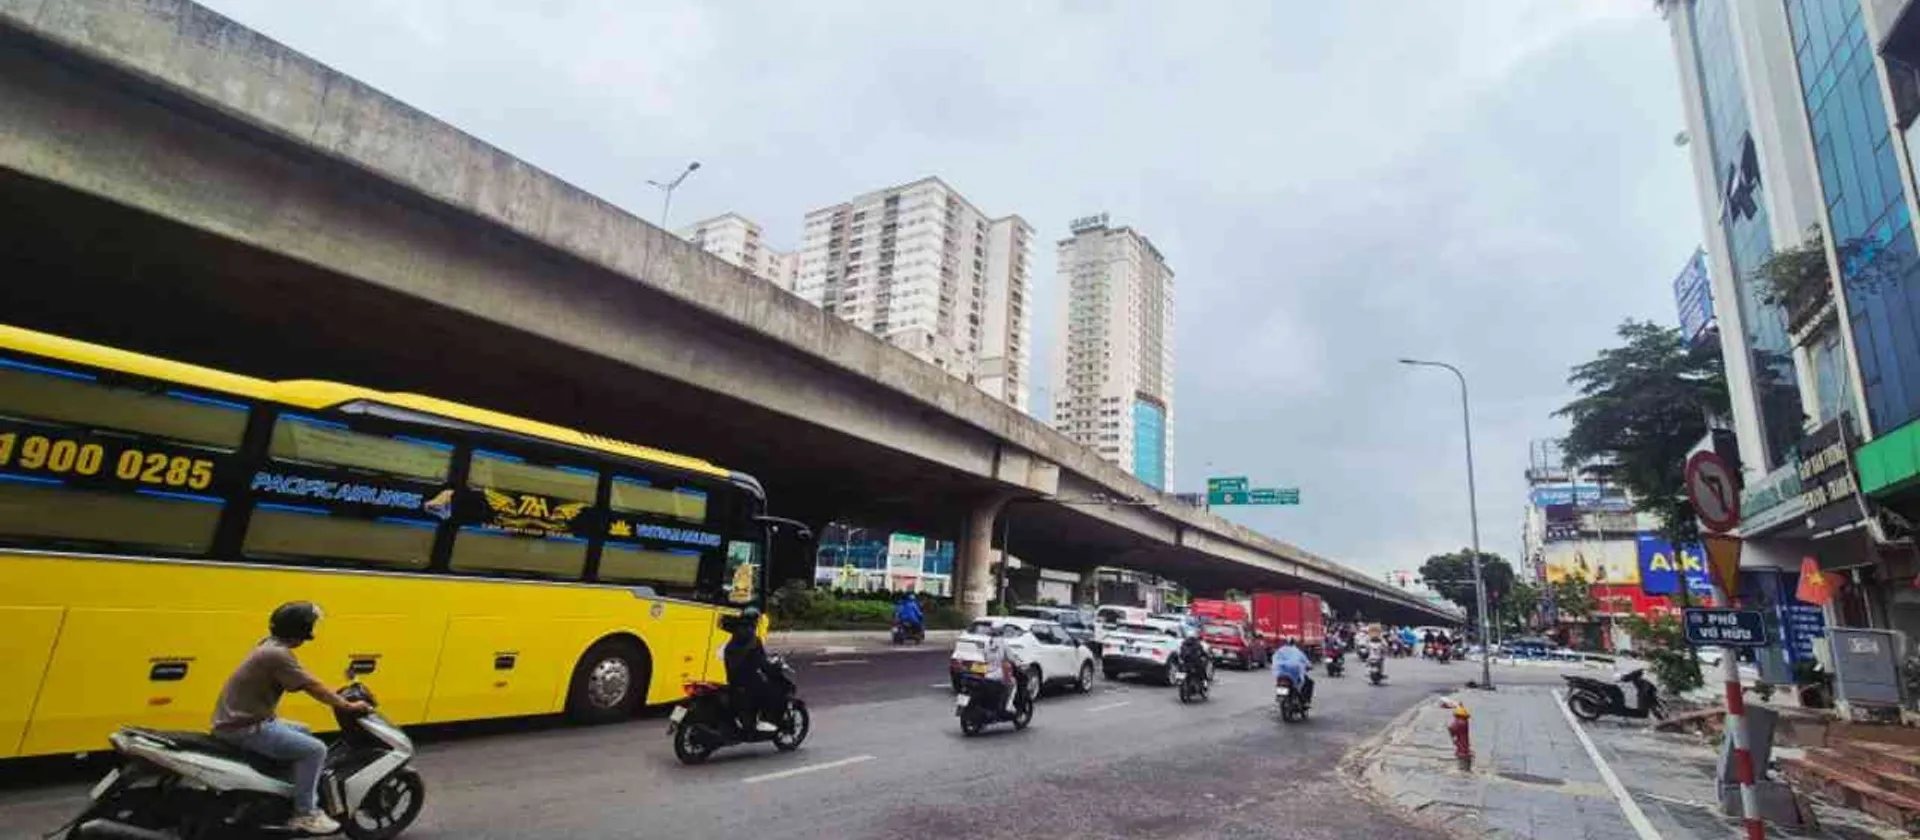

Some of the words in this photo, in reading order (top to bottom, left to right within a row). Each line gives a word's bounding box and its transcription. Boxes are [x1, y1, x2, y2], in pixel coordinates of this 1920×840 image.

[0, 432, 104, 476] 1900
[116, 449, 214, 490] 0285
[251, 471, 338, 499] PACIFIC
